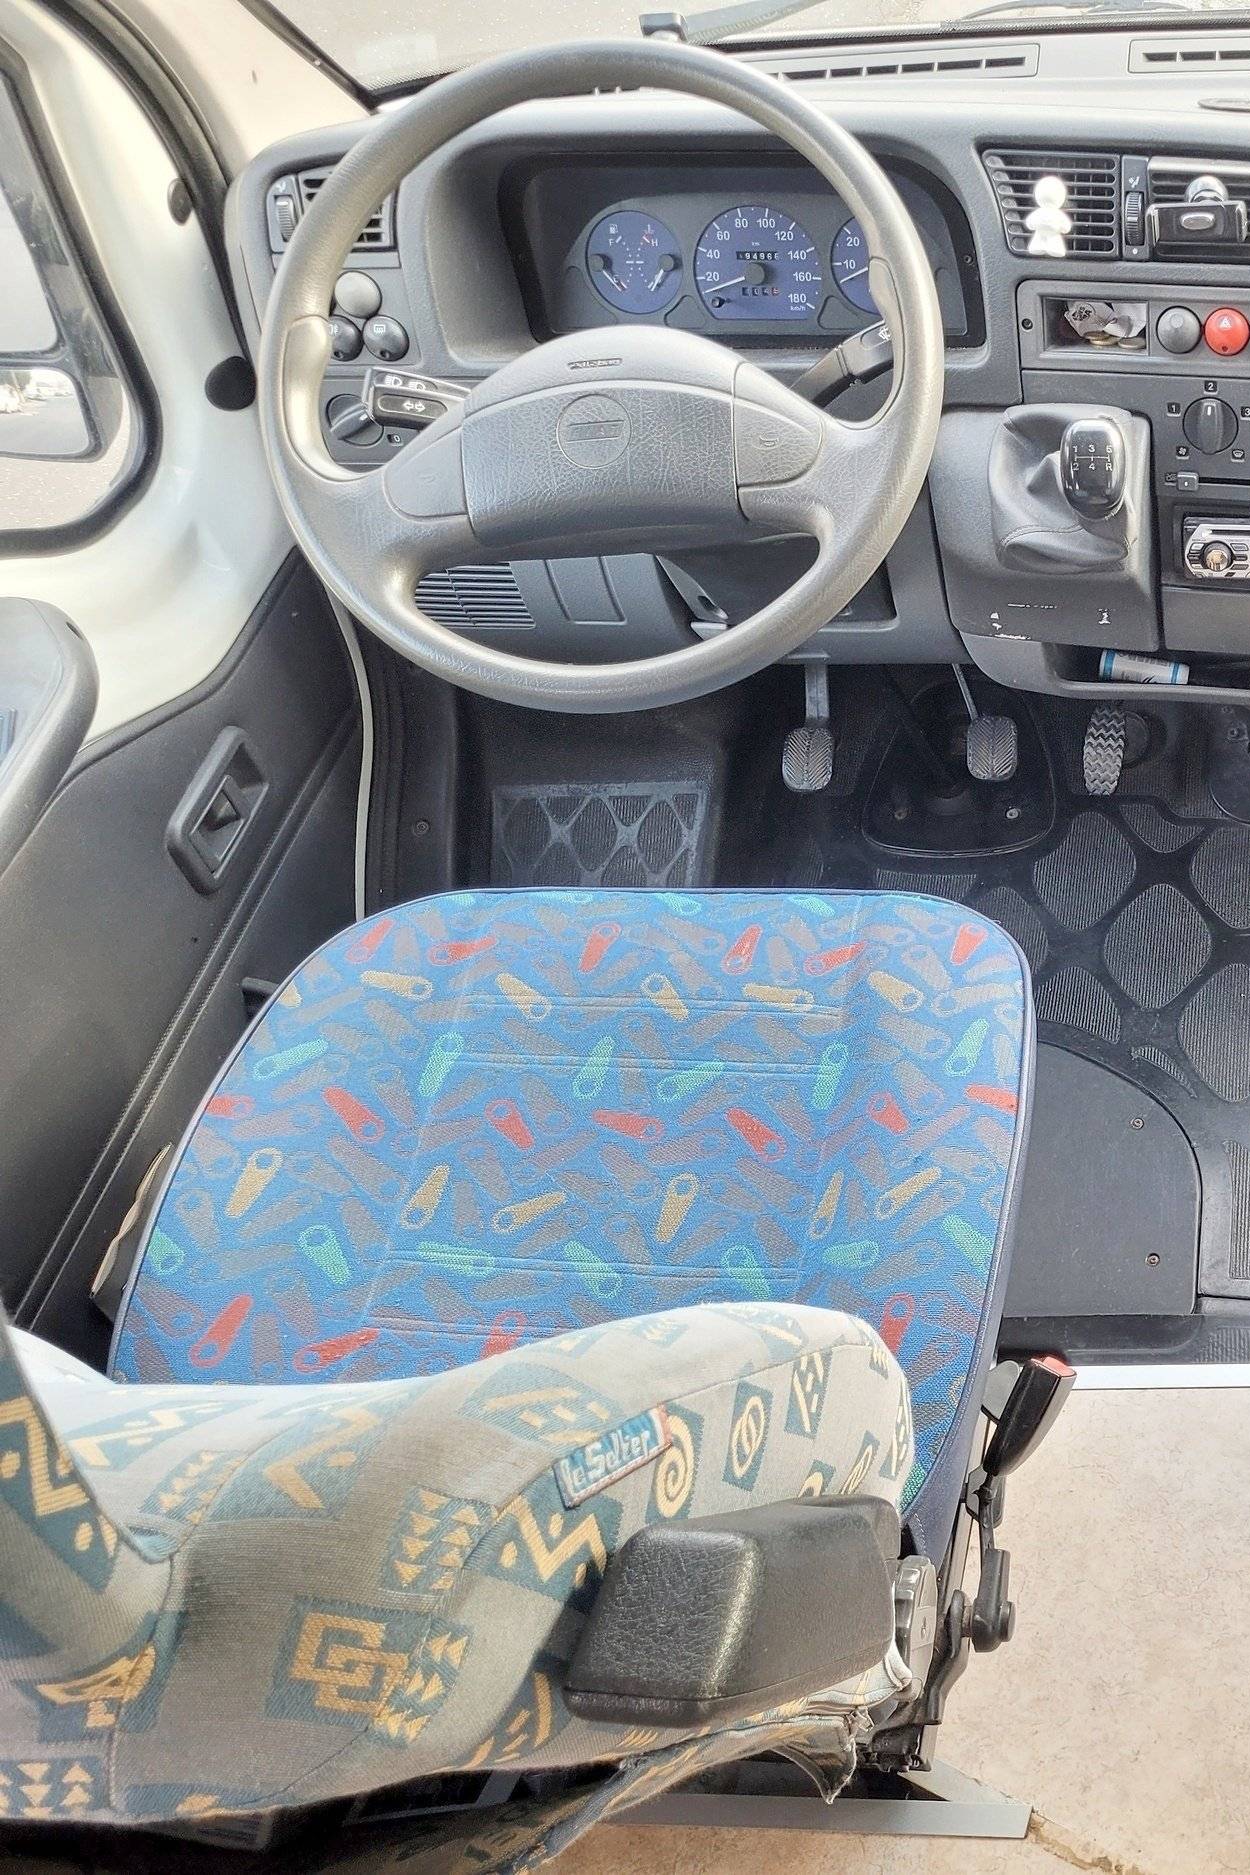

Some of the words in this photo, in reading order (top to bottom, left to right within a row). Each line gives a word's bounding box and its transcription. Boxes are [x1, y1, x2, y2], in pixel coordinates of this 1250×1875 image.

[735, 218, 748, 228] 80
[757, 218, 776, 228] 100
[716, 231, 730, 241] 60
[775, 231, 794, 241] 120
[608, 239, 615, 247] F
[651, 238, 659, 247] H
[846, 237, 860, 247] 20
[706, 249, 720, 259] 40
[787, 250, 807, 260] 140
[843, 259, 856, 270] 10
[705, 271, 720, 281] 20
[793, 272, 812, 282] 160
[787, 293, 807, 303] 180
[1207, 382, 1214, 391] 2
[1244, 408, 1250, 416] 3
[1088, 444, 1096, 453] 3
[1106, 445, 1113, 454] 5
[1072, 462, 1079, 471] 2
[1088, 463, 1096, 471] 4
[1105, 463, 1113, 472] R
